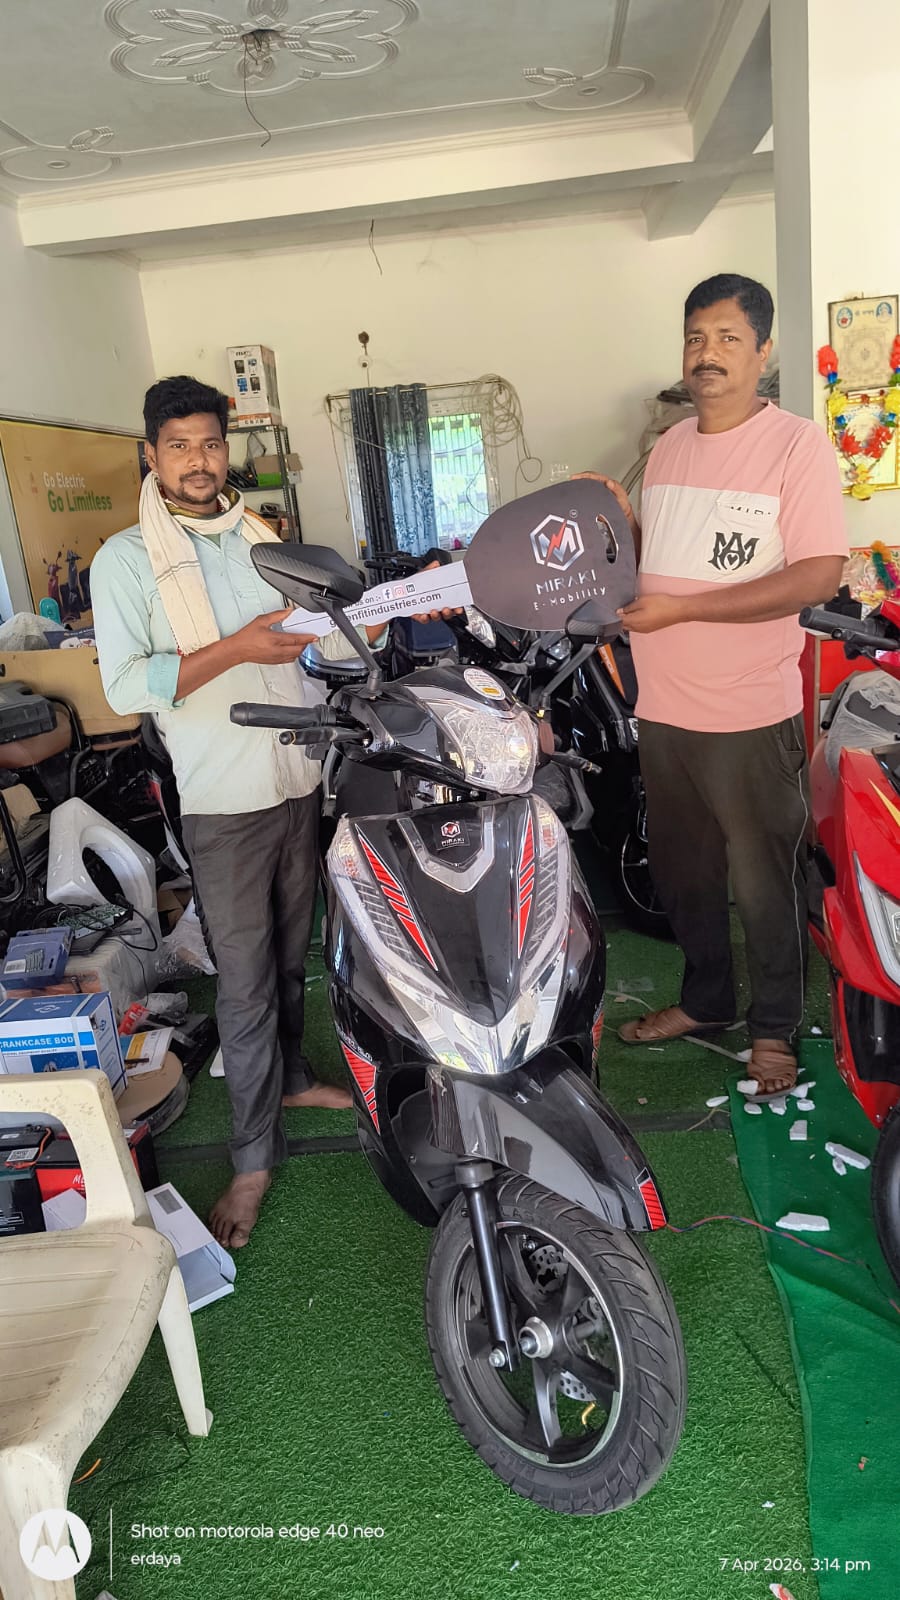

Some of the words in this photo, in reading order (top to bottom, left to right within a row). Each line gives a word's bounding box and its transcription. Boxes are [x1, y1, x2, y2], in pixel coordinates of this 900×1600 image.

[43, 472, 55, 488] Go
[56, 472, 86, 488] Electric
[47, 489, 64, 512] Go
[65, 490, 113, 512] Limitless
[535, 569, 597, 595] MIRAKI
[329, 591, 442, 628] genfitindustries.com
[54, 1036, 74, 1044] BOD
